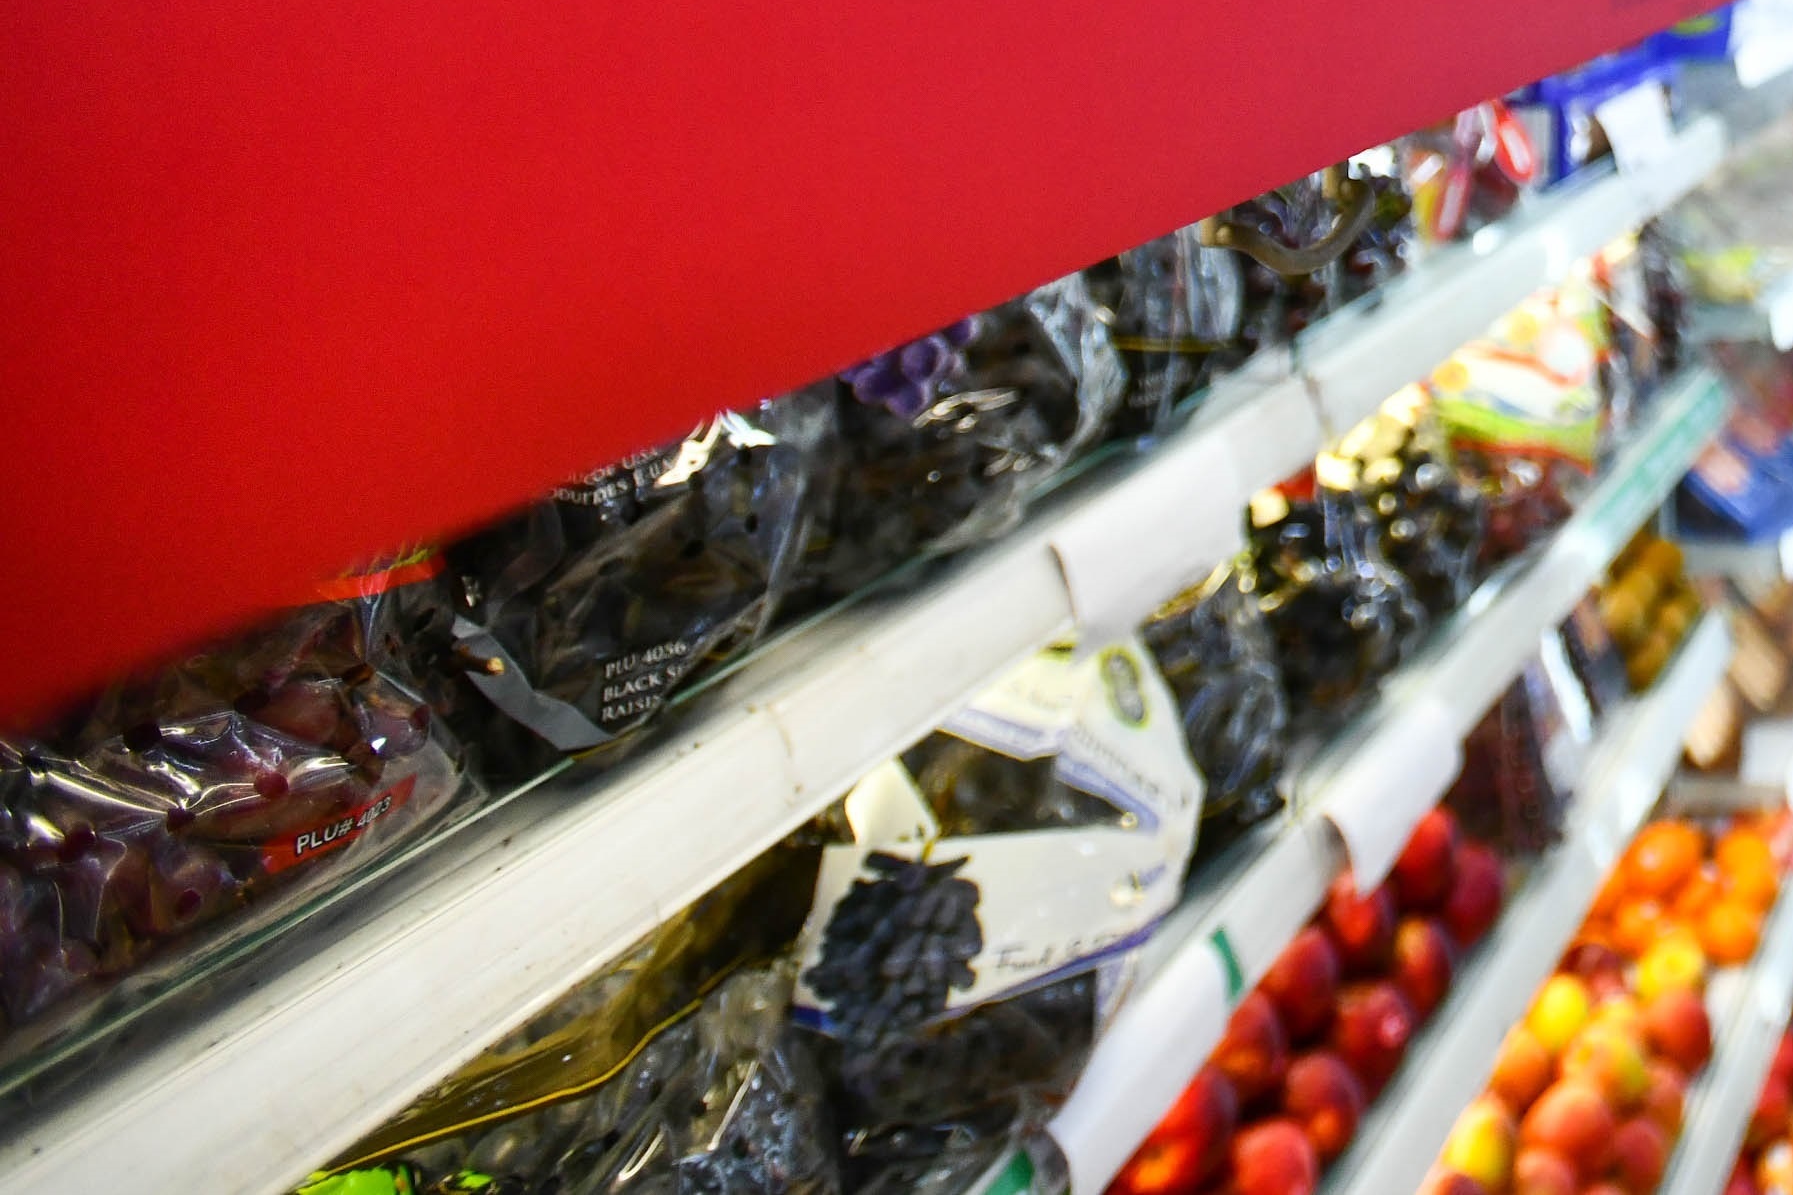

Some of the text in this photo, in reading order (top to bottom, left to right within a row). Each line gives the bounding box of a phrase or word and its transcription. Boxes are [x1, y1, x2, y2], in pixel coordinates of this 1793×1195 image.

[604, 654, 637, 679] PLU
[603, 671, 662, 702] BLACK
[296, 795, 393, 856] PLU# 4023
